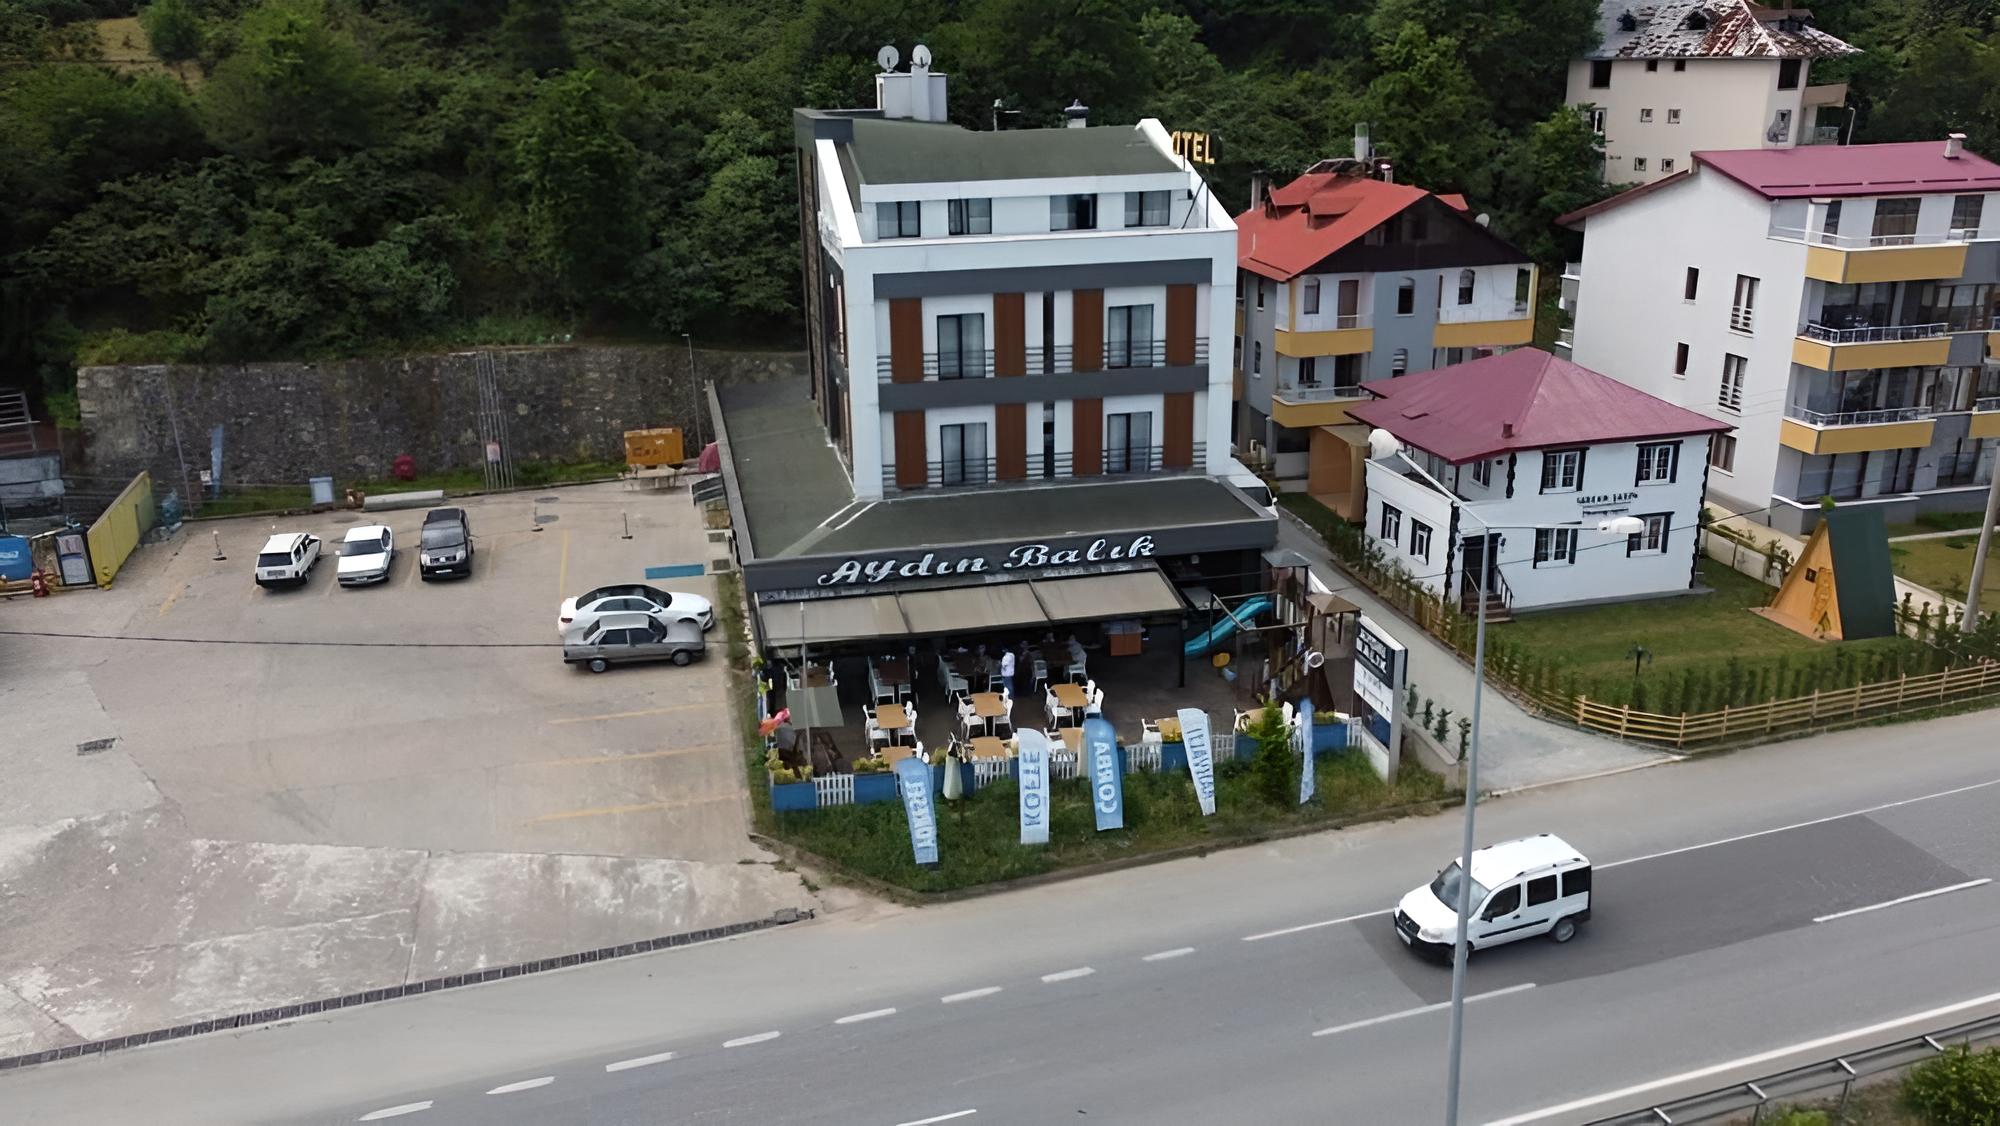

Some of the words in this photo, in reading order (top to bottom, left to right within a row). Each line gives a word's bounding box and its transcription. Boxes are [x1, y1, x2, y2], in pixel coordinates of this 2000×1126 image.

[1171, 130, 1215, 165] OTEL
[817, 553, 988, 586] Aydın
[1003, 535, 1155, 568] Balık
